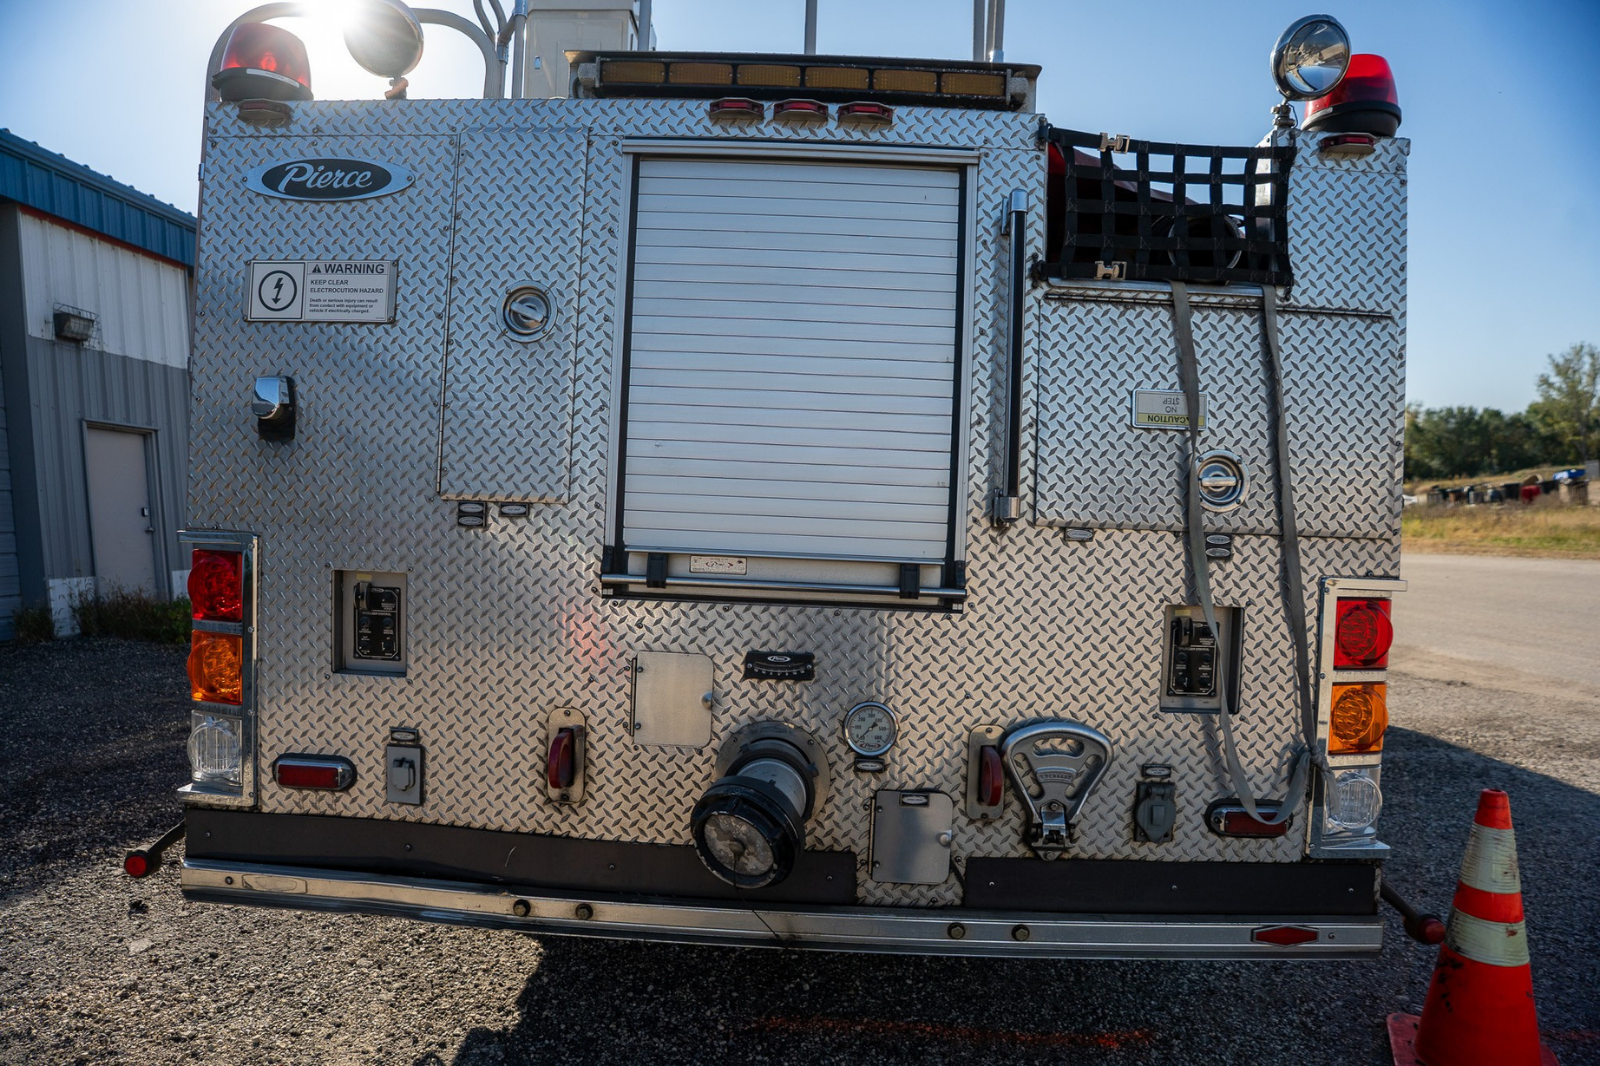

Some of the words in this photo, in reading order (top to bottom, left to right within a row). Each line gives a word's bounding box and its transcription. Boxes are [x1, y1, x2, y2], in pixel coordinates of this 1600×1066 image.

[277, 162, 373, 193] Pierce
[324, 263, 385, 274] WARNING
[1147, 414, 1186, 424] CAUTION
